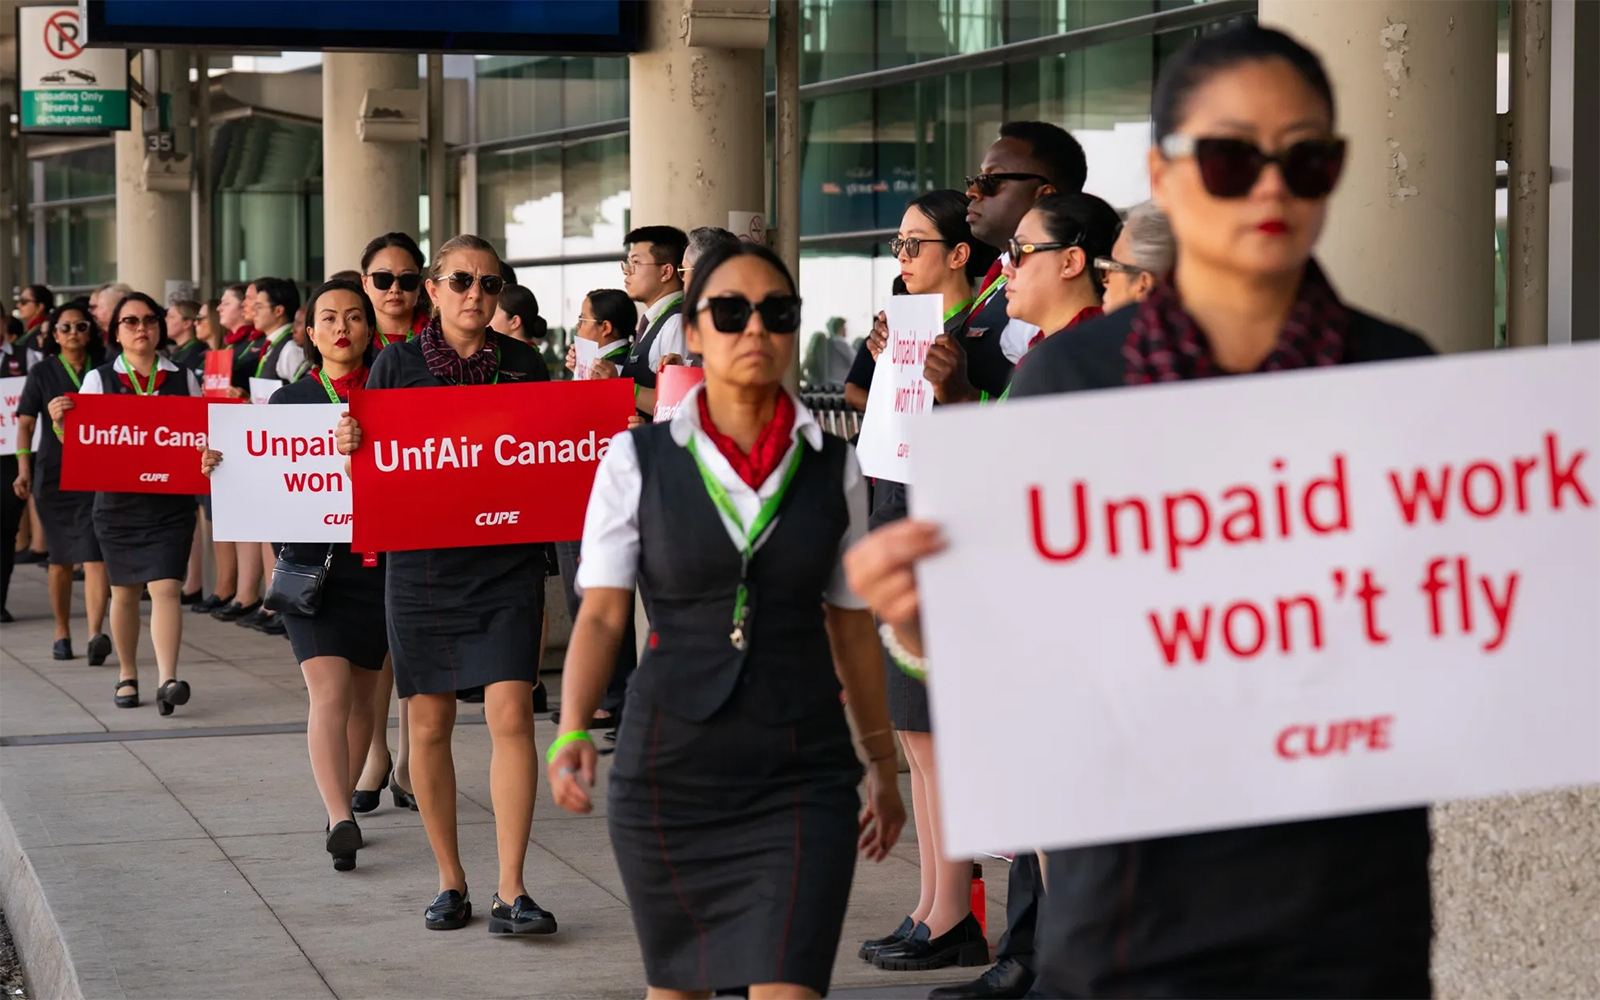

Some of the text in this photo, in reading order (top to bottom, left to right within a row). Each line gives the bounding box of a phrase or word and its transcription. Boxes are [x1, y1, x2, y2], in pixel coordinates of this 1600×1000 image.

[80, 91, 104, 103] Only
[149, 135, 171, 151] 35
[79, 424, 209, 447] UnfAir Cana
[246, 430, 351, 462] Unpai
[373, 436, 483, 473] UnfAir
[139, 473, 170, 482] CUPE
[1026, 430, 1594, 572] Unpaid work
[323, 514, 353, 525] CUP
[475, 511, 521, 526] CUPE
[1148, 553, 1521, 668] won't fly
[1273, 713, 1395, 762] CUPE
